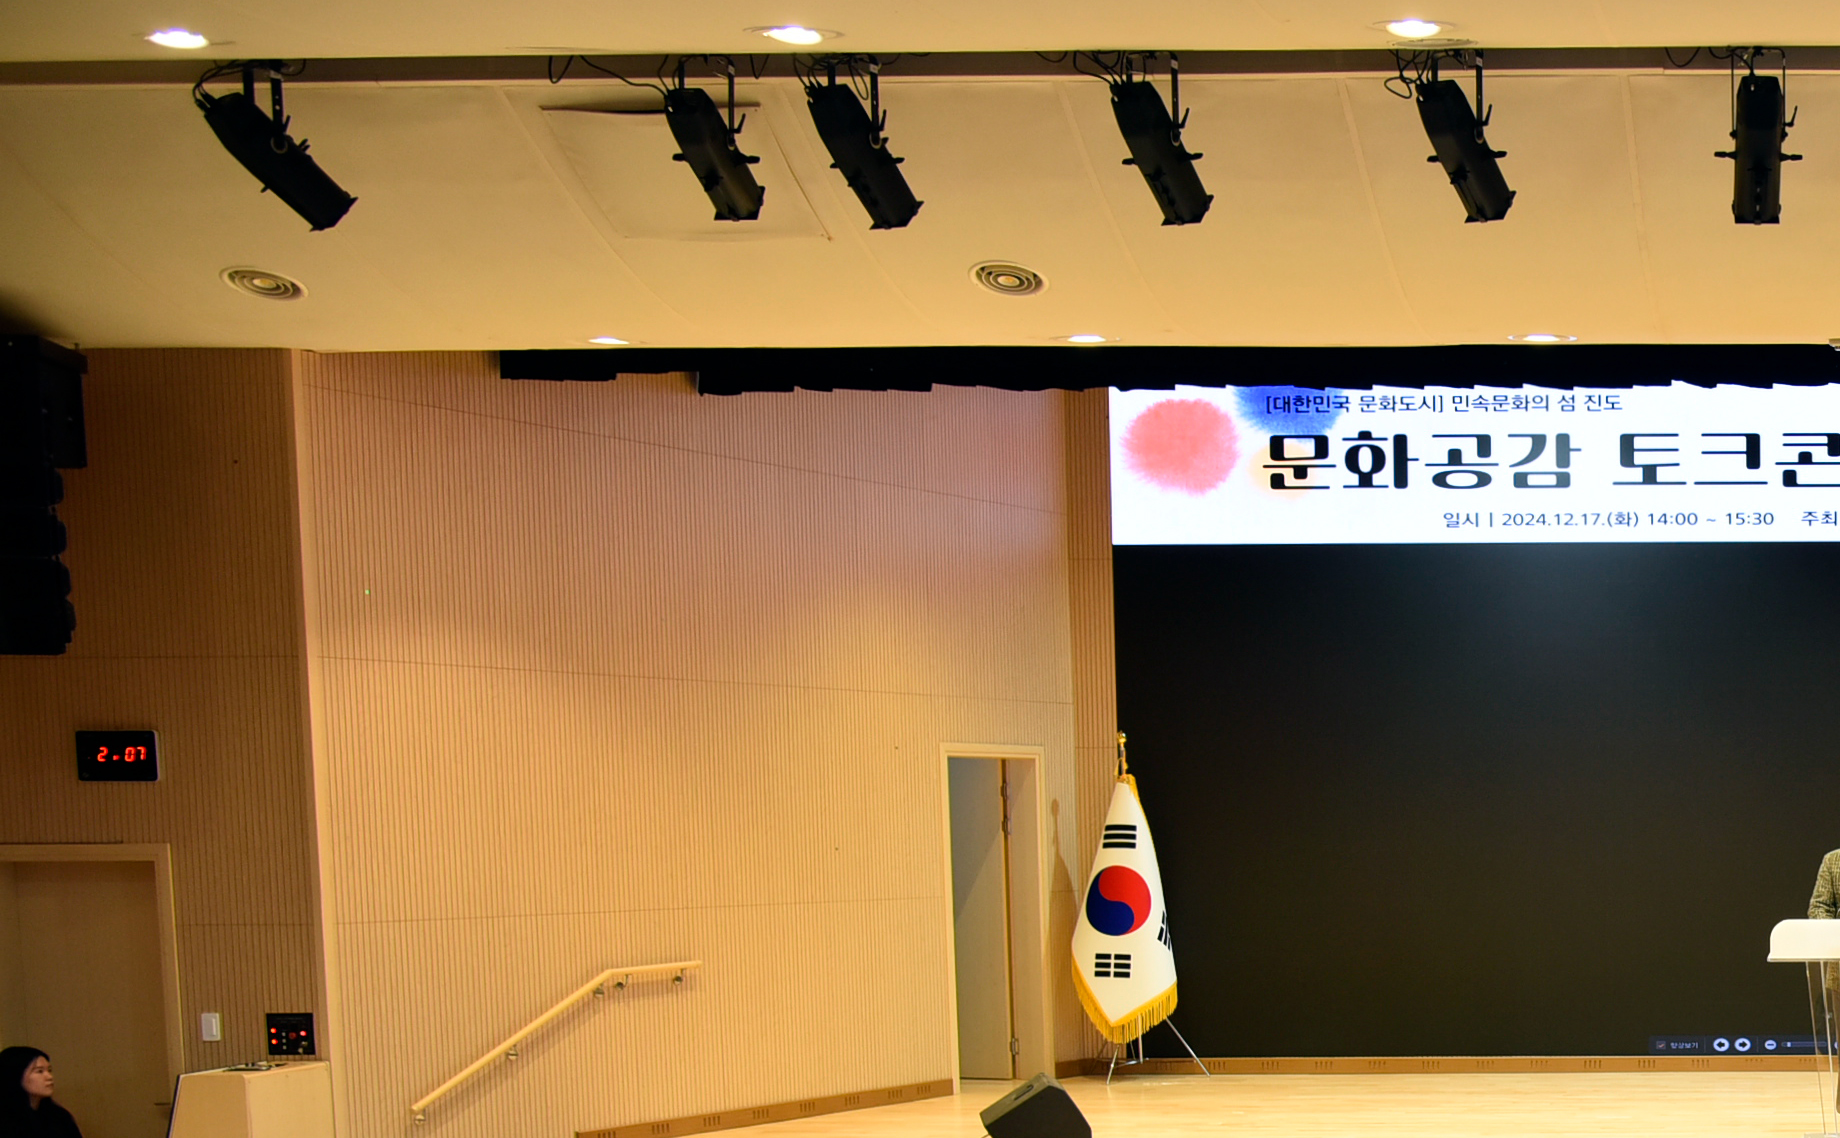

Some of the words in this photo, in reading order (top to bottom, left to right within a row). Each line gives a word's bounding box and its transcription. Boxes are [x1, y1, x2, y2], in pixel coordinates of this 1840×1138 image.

[1266, 394, 1351, 413] [대한민국
[1358, 394, 1443, 413] 문화도시]
[1452, 394, 1549, 413] 민속문화의
[1557, 394, 1575, 413] 섬
[1584, 394, 1623, 412] 진도
[1262, 430, 1582, 489] 문화공감
[1443, 512, 1480, 528] 일시
[1502, 512, 1639, 528] 2024.12.17.(화)
[1648, 512, 1698, 526] 14:00
[1725, 512, 1775, 526] 15:30
[1801, 511, 1838, 527] 주최
